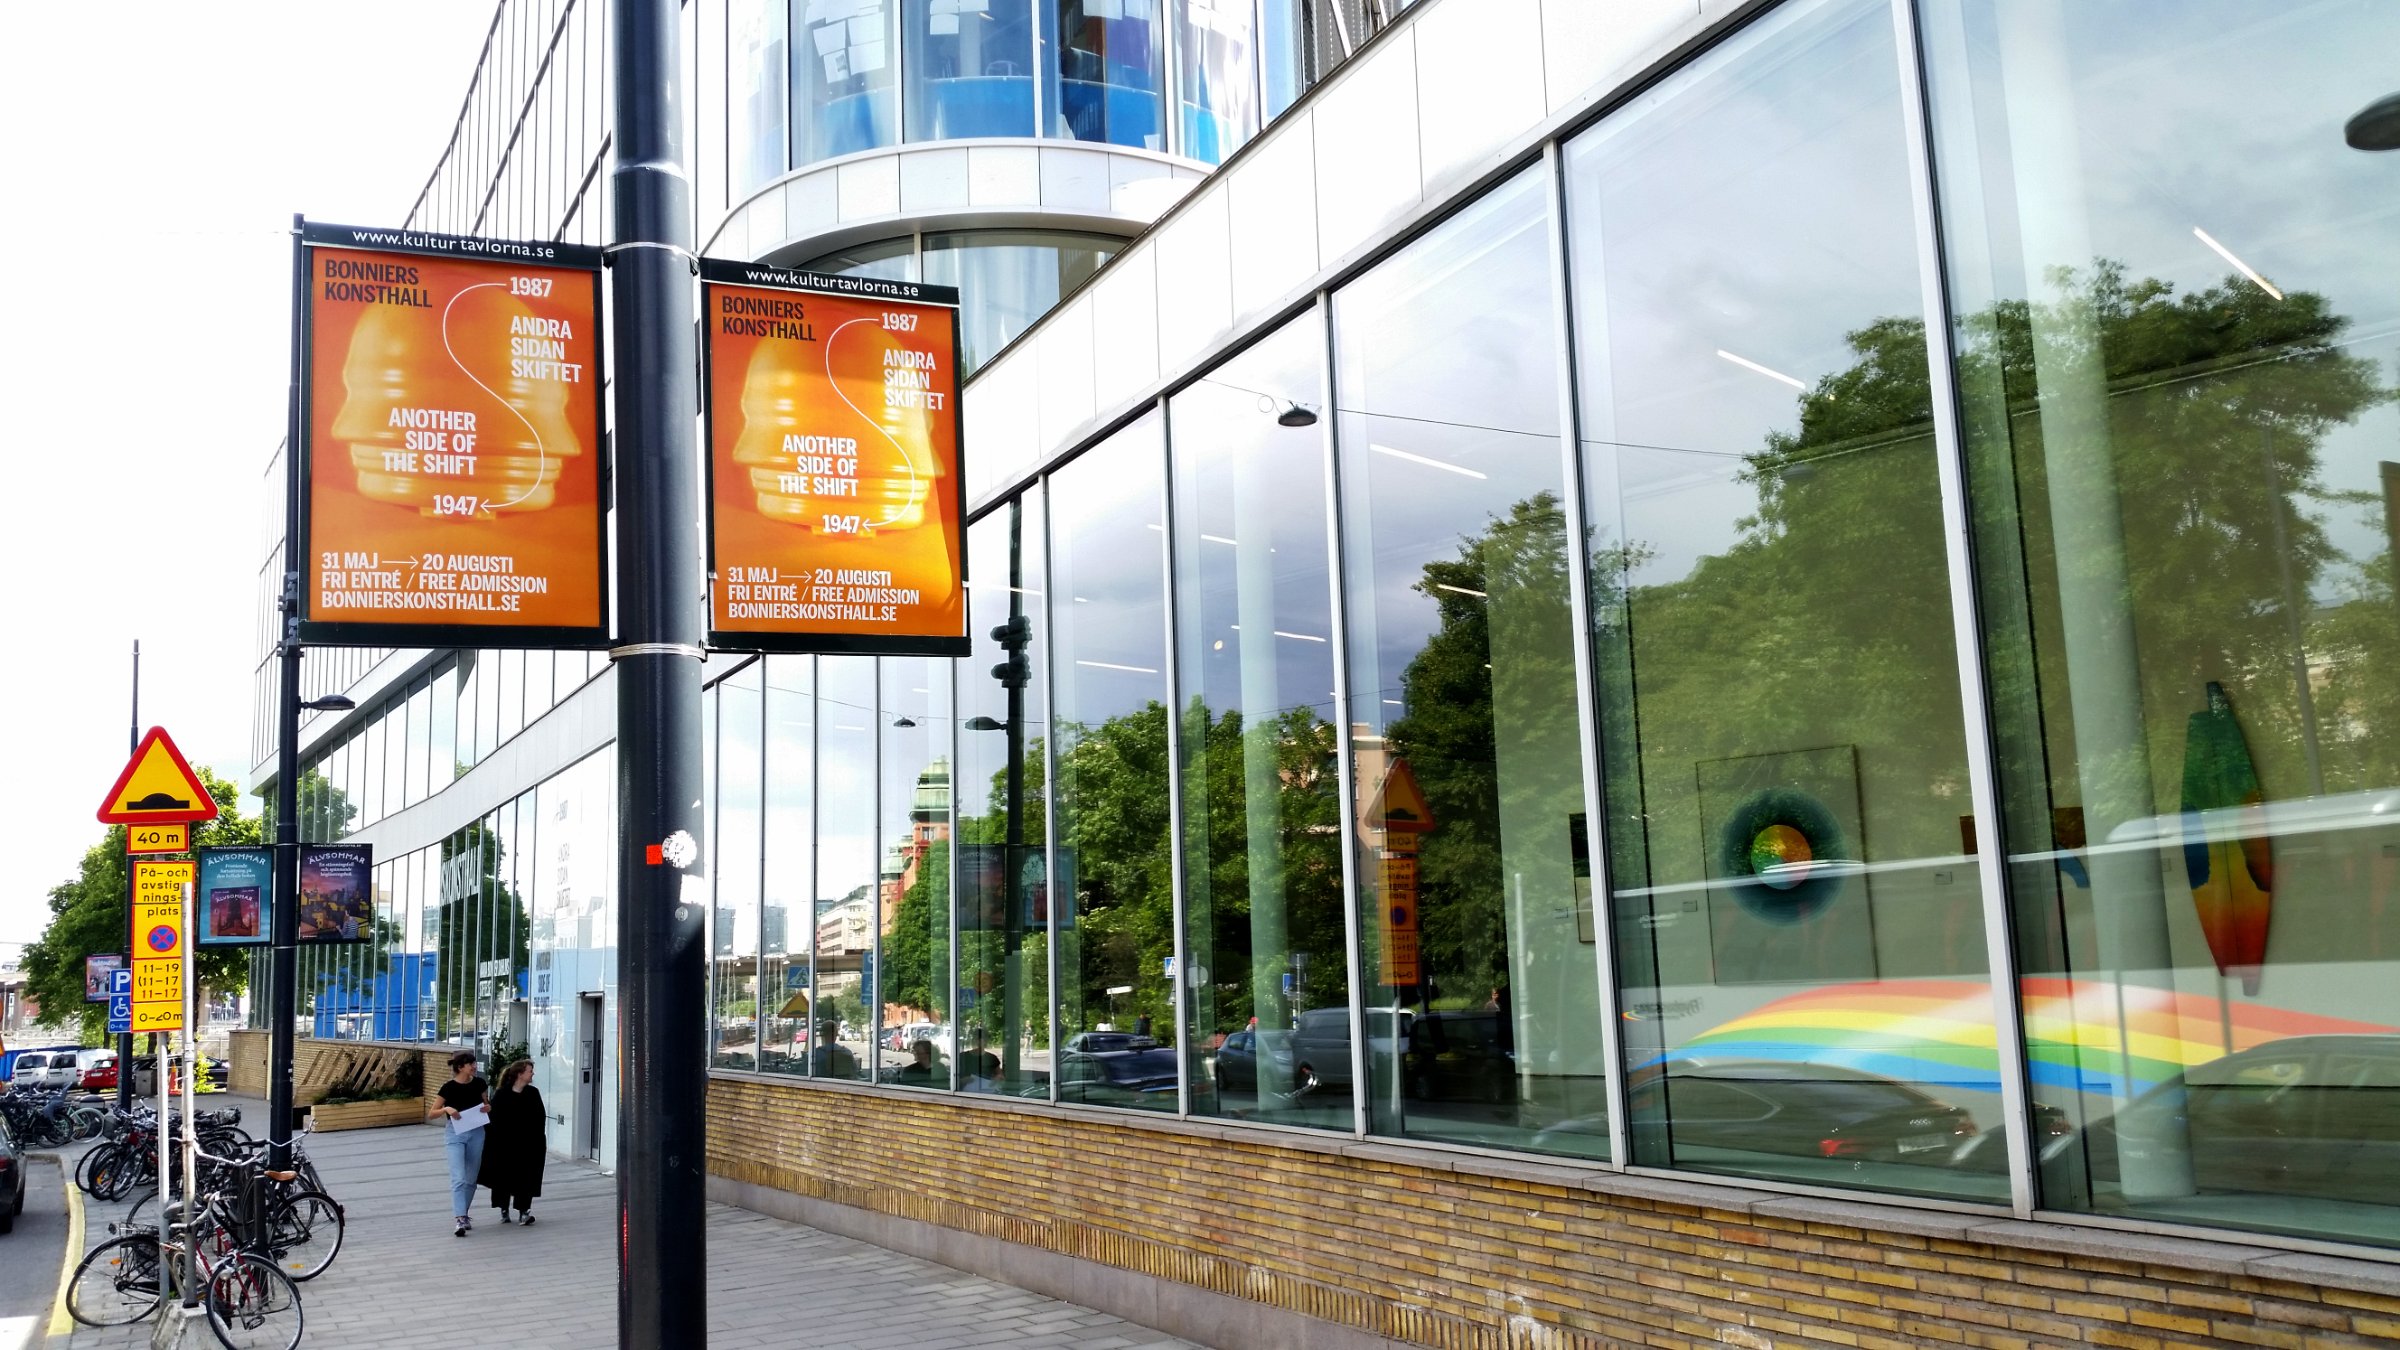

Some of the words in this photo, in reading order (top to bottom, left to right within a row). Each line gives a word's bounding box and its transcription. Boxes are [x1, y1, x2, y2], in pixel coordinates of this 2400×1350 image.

[352, 231, 555, 258] www.kulturtavlorna.se
[325, 259, 419, 285] BONNIERS
[324, 281, 433, 308] KONSTHALL
[510, 276, 553, 297] 1987
[745, 270, 919, 297] www.kulturtavlorna.se
[722, 295, 804, 320] BONNIERS
[510, 315, 573, 339] ANDRA
[722, 316, 817, 342] KONSTHALL
[881, 312, 918, 332] 1987
[510, 337, 565, 360] SIDAN
[883, 348, 937, 370] ANDRA
[511, 359, 582, 383] SKIFTET
[884, 368, 930, 390] SIDAN
[884, 388, 945, 411] SKIFTET
[388, 407, 477, 432] ANOTHER
[405, 430, 448, 452] SIDE
[452, 433, 477, 453] OF
[782, 434, 857, 456] ANOTHER
[381, 451, 419, 473] THE
[423, 453, 478, 476] SHIFT
[797, 455, 833, 475] SIDE
[837, 457, 858, 476] OF
[777, 475, 809, 494] THE
[813, 476, 859, 497] SHIFT
[433, 494, 478, 516] 1947
[822, 514, 860, 534] 1947
[321, 552, 340, 569] 31
[344, 552, 379, 569] MAJ
[422, 553, 444, 571] 20
[446, 555, 514, 574] AUGUSTI
[321, 571, 347, 589] FRI
[350, 569, 402, 589] ENTRÉ
[419, 573, 457, 591] FREE
[460, 575, 548, 594] ADMISSION
[728, 567, 743, 583] 31
[747, 567, 777, 583] MAJ
[815, 569, 833, 585] 20
[836, 570, 892, 587] AUGUSTI
[321, 591, 521, 612] BONNIERSKONSTHALL.SE
[728, 585, 750, 601] FRI
[754, 583, 797, 602] ENTRÉ
[812, 586, 844, 603] FREE
[847, 588, 920, 605] ADMISSION
[728, 602, 897, 622] BONNIERSKONSTHALL.SE
[137, 832, 160, 844] 40
[166, 834, 179, 843] m
[206, 853, 266, 867] ÄLVSOMMAR
[307, 852, 366, 865] ÄLVSOMMAR
[166, 868, 188, 877] och
[147, 907, 179, 918] plats
[115, 971, 130, 992] P
